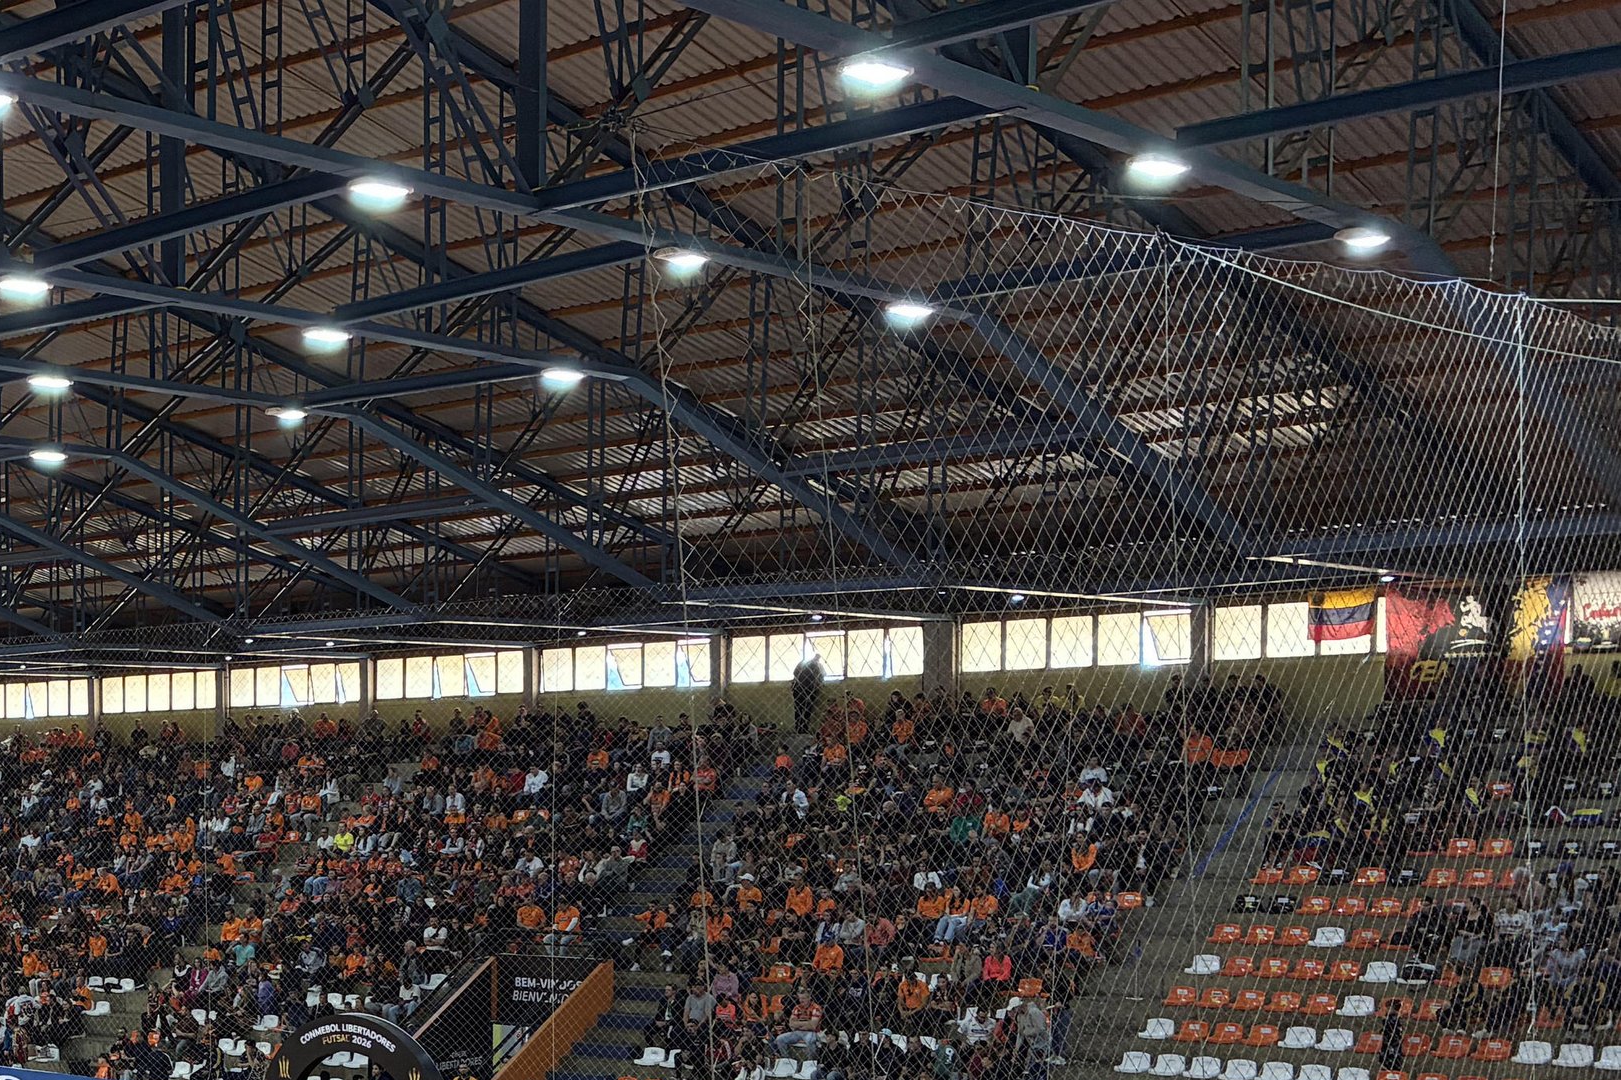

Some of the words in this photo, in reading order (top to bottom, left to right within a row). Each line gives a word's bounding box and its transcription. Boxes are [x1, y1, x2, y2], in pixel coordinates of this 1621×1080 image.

[299, 1023, 341, 1045] CONMEBOL
[341, 1023, 396, 1053] LIBERTADORES
[351, 1034, 372, 1049] 2026
